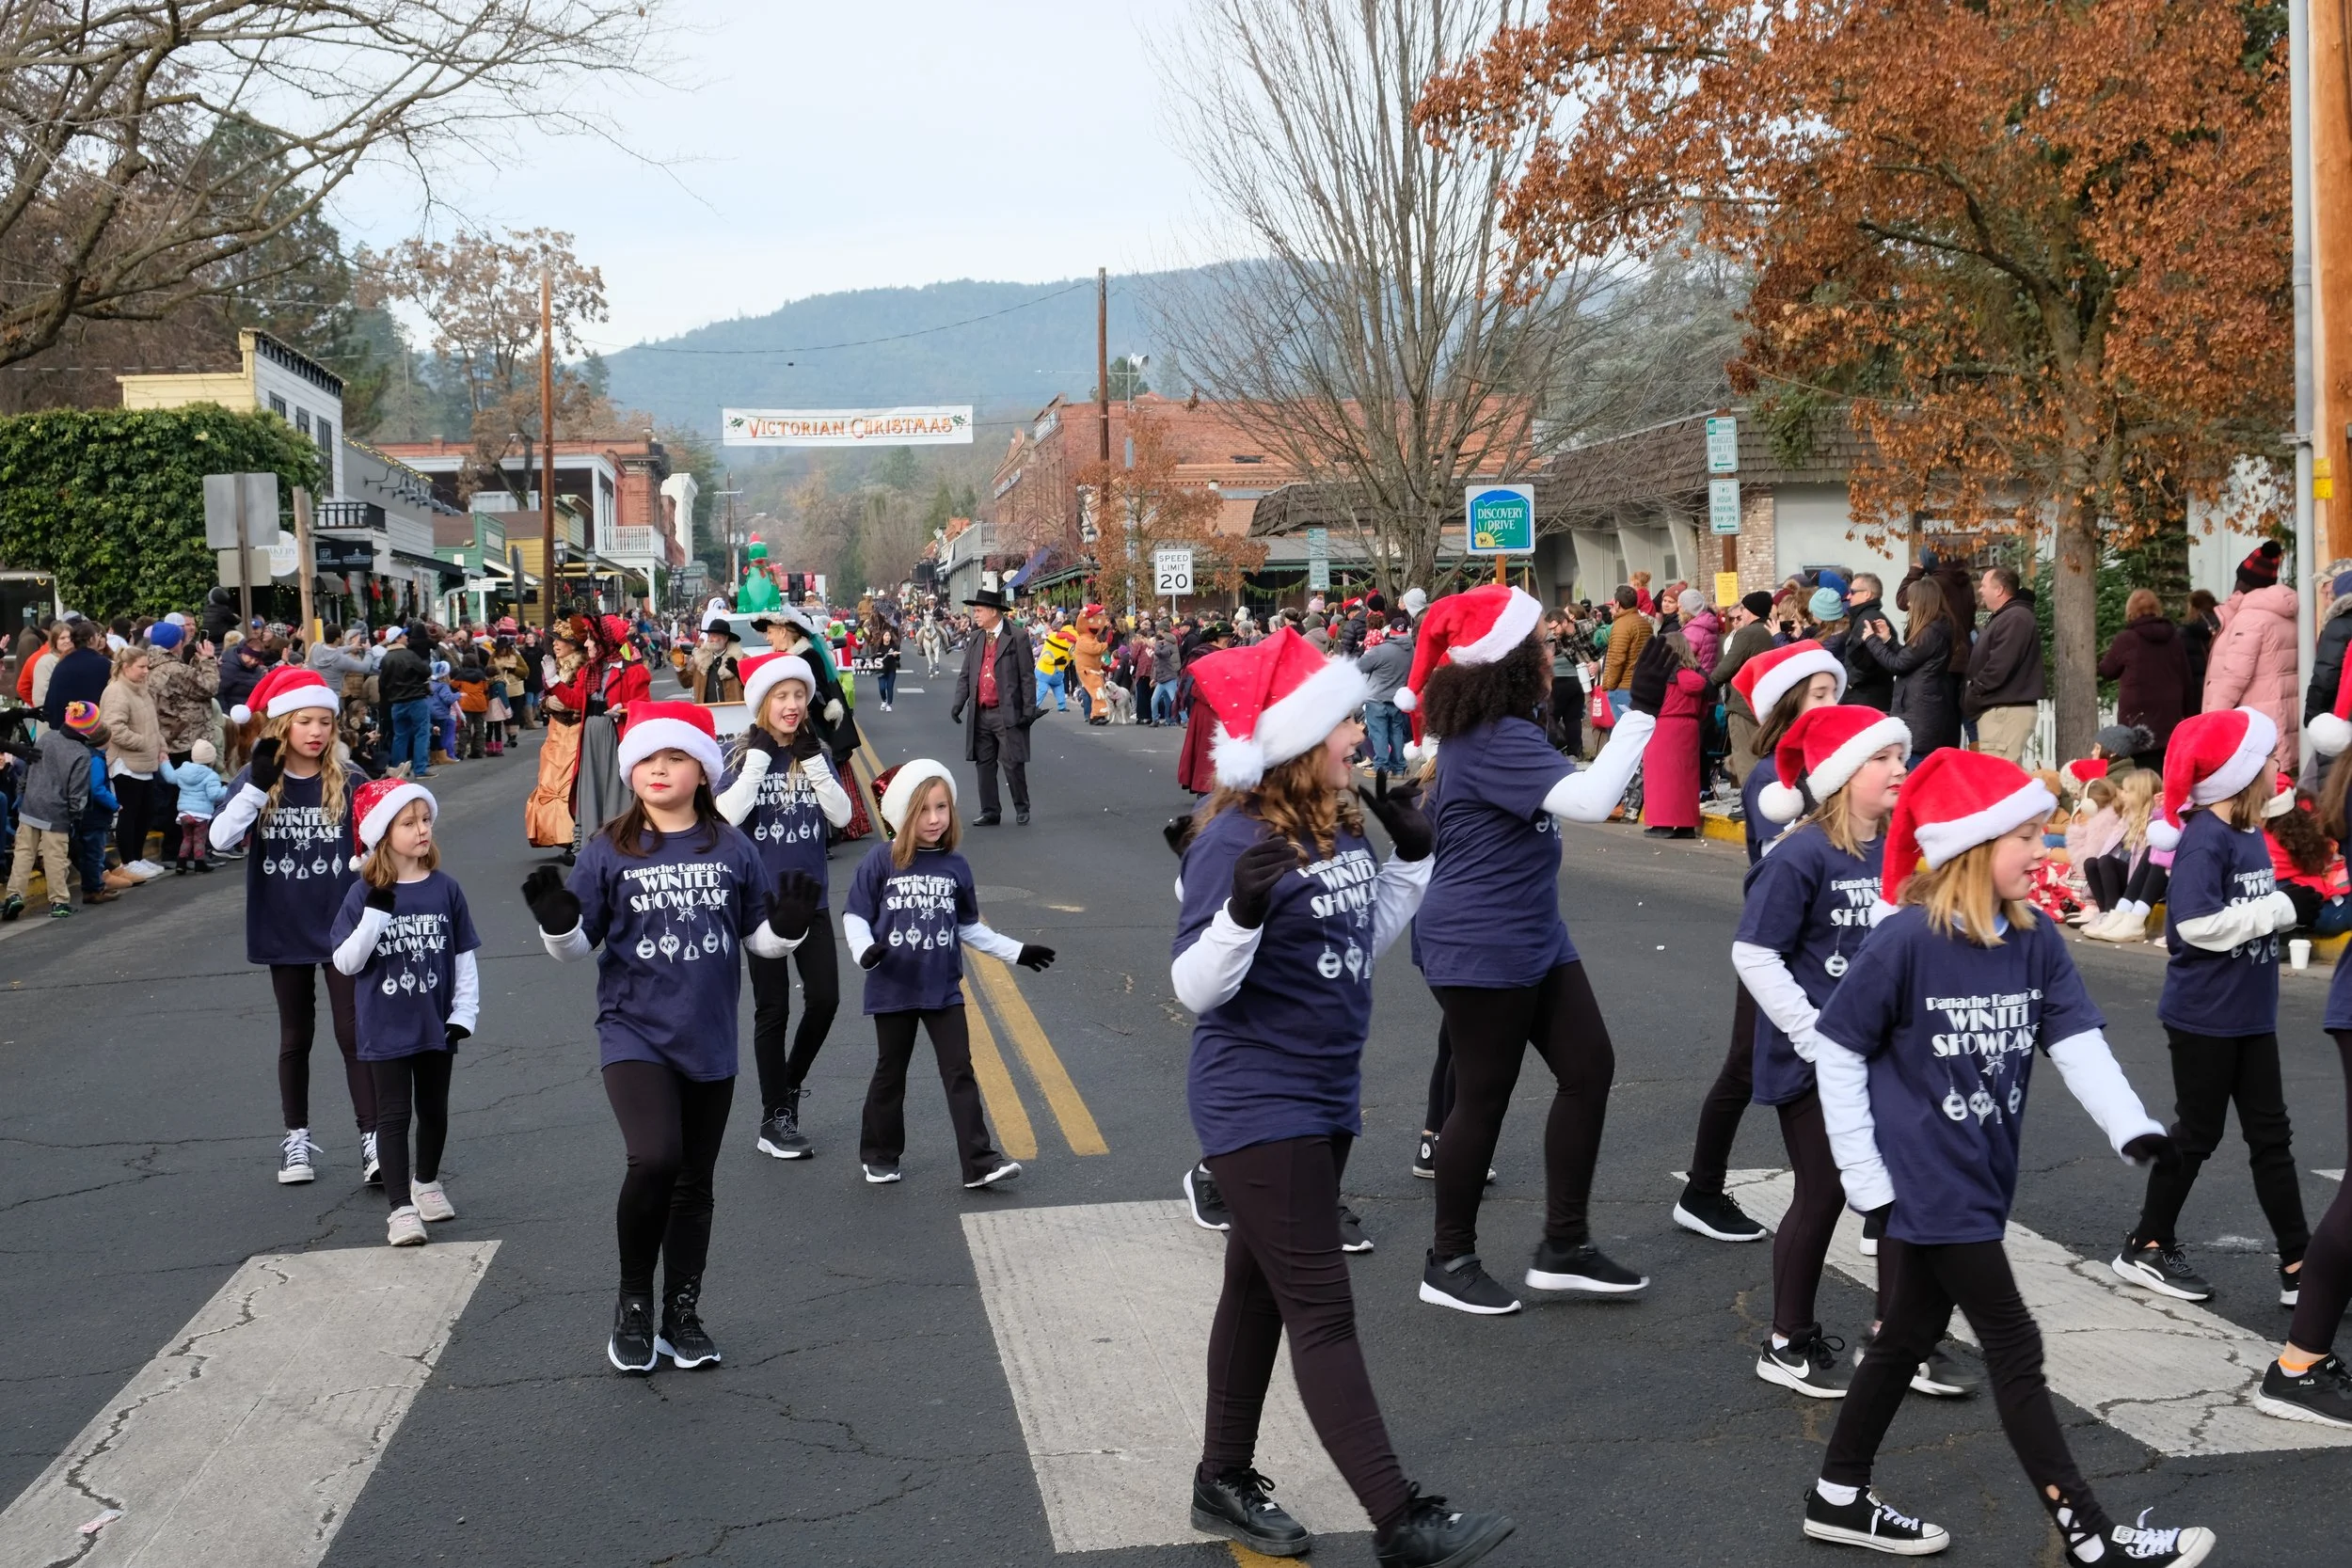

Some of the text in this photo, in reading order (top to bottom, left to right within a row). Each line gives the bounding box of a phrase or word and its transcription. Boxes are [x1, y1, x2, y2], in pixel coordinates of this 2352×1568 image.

[749, 416, 953, 439] VICTORIAN CHRISTMAS
[1477, 508, 1523, 519] DISCOVERY
[1487, 519, 1516, 531] DRIVE
[1160, 574, 1187, 589] 20
[760, 779, 812, 792] WINER
[262, 825, 343, 839] SHOWCASE
[624, 862, 732, 880] Panache Dance Co.
[639, 871, 721, 893] WINTER
[630, 888, 730, 912] SHOWCASE
[385, 921, 440, 940] WINTER
[376, 935, 447, 958] SHOWCASE
[1926, 995, 1991, 1011] Panache
